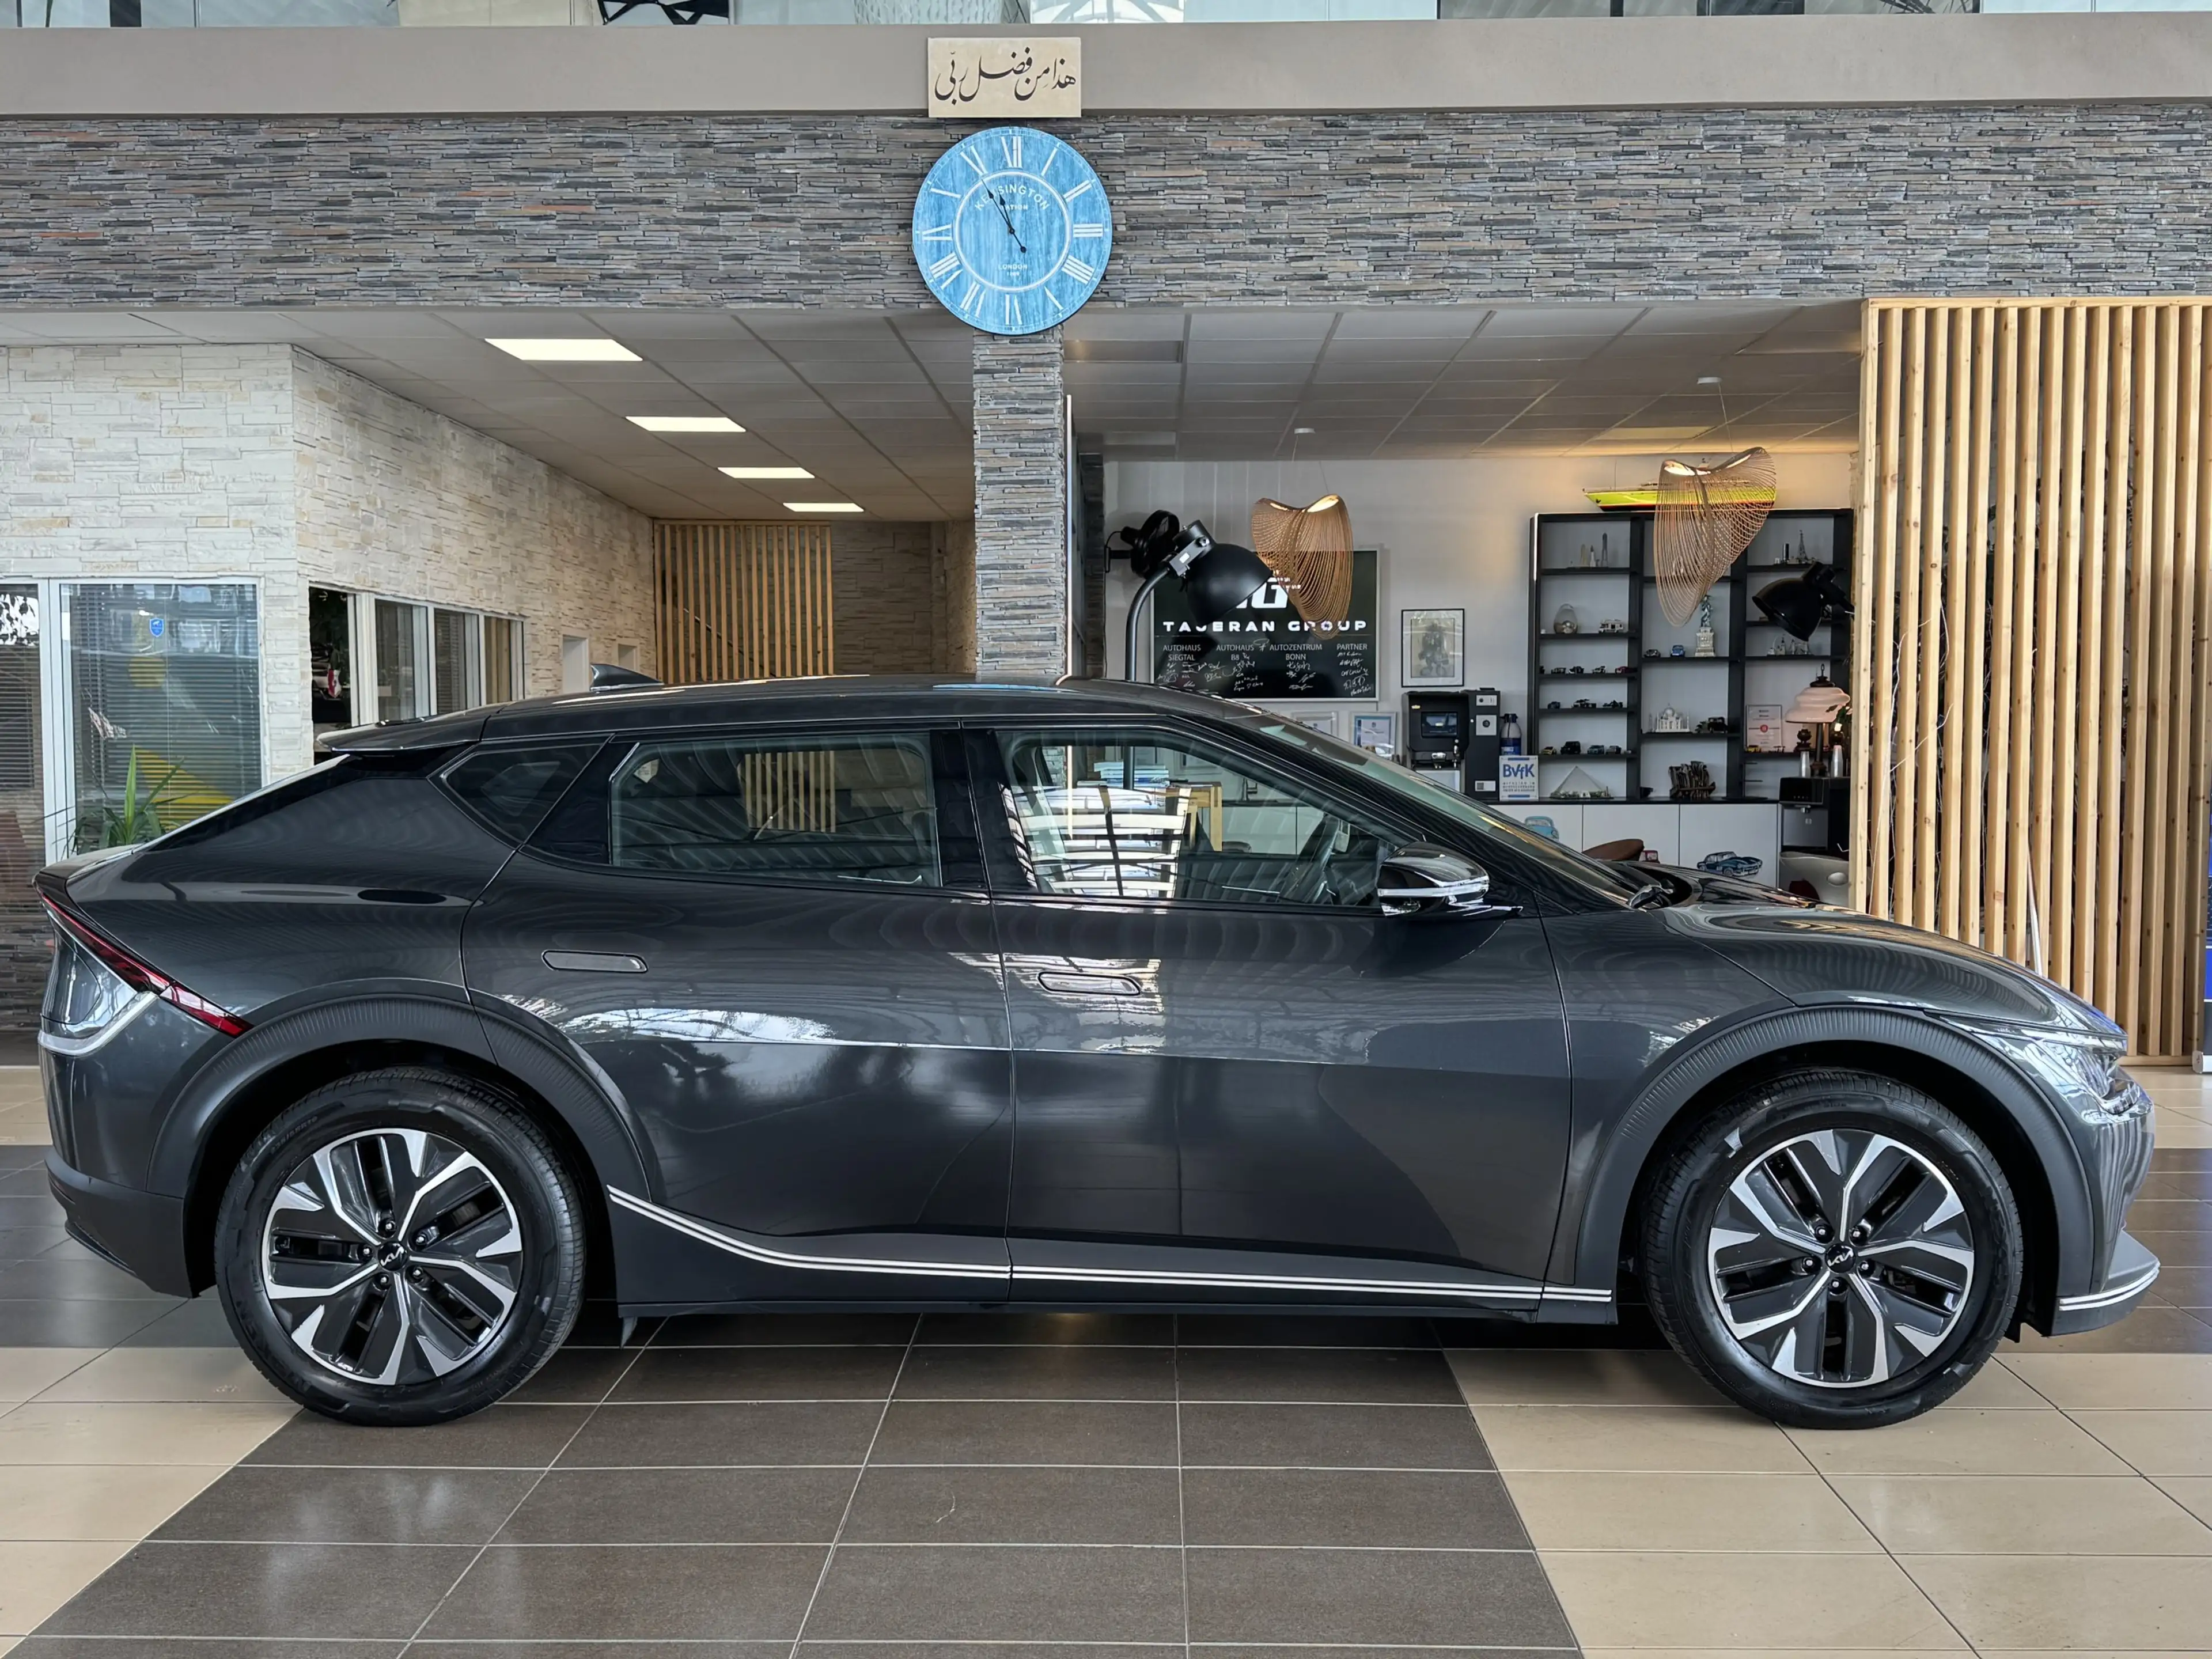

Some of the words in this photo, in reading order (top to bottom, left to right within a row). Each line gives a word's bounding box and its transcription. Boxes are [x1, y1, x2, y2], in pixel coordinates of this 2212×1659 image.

[1162, 620, 1275, 632] TAJERAN
[1287, 620, 1366, 632] GROUP
[1502, 763, 1535, 779] BVfK
